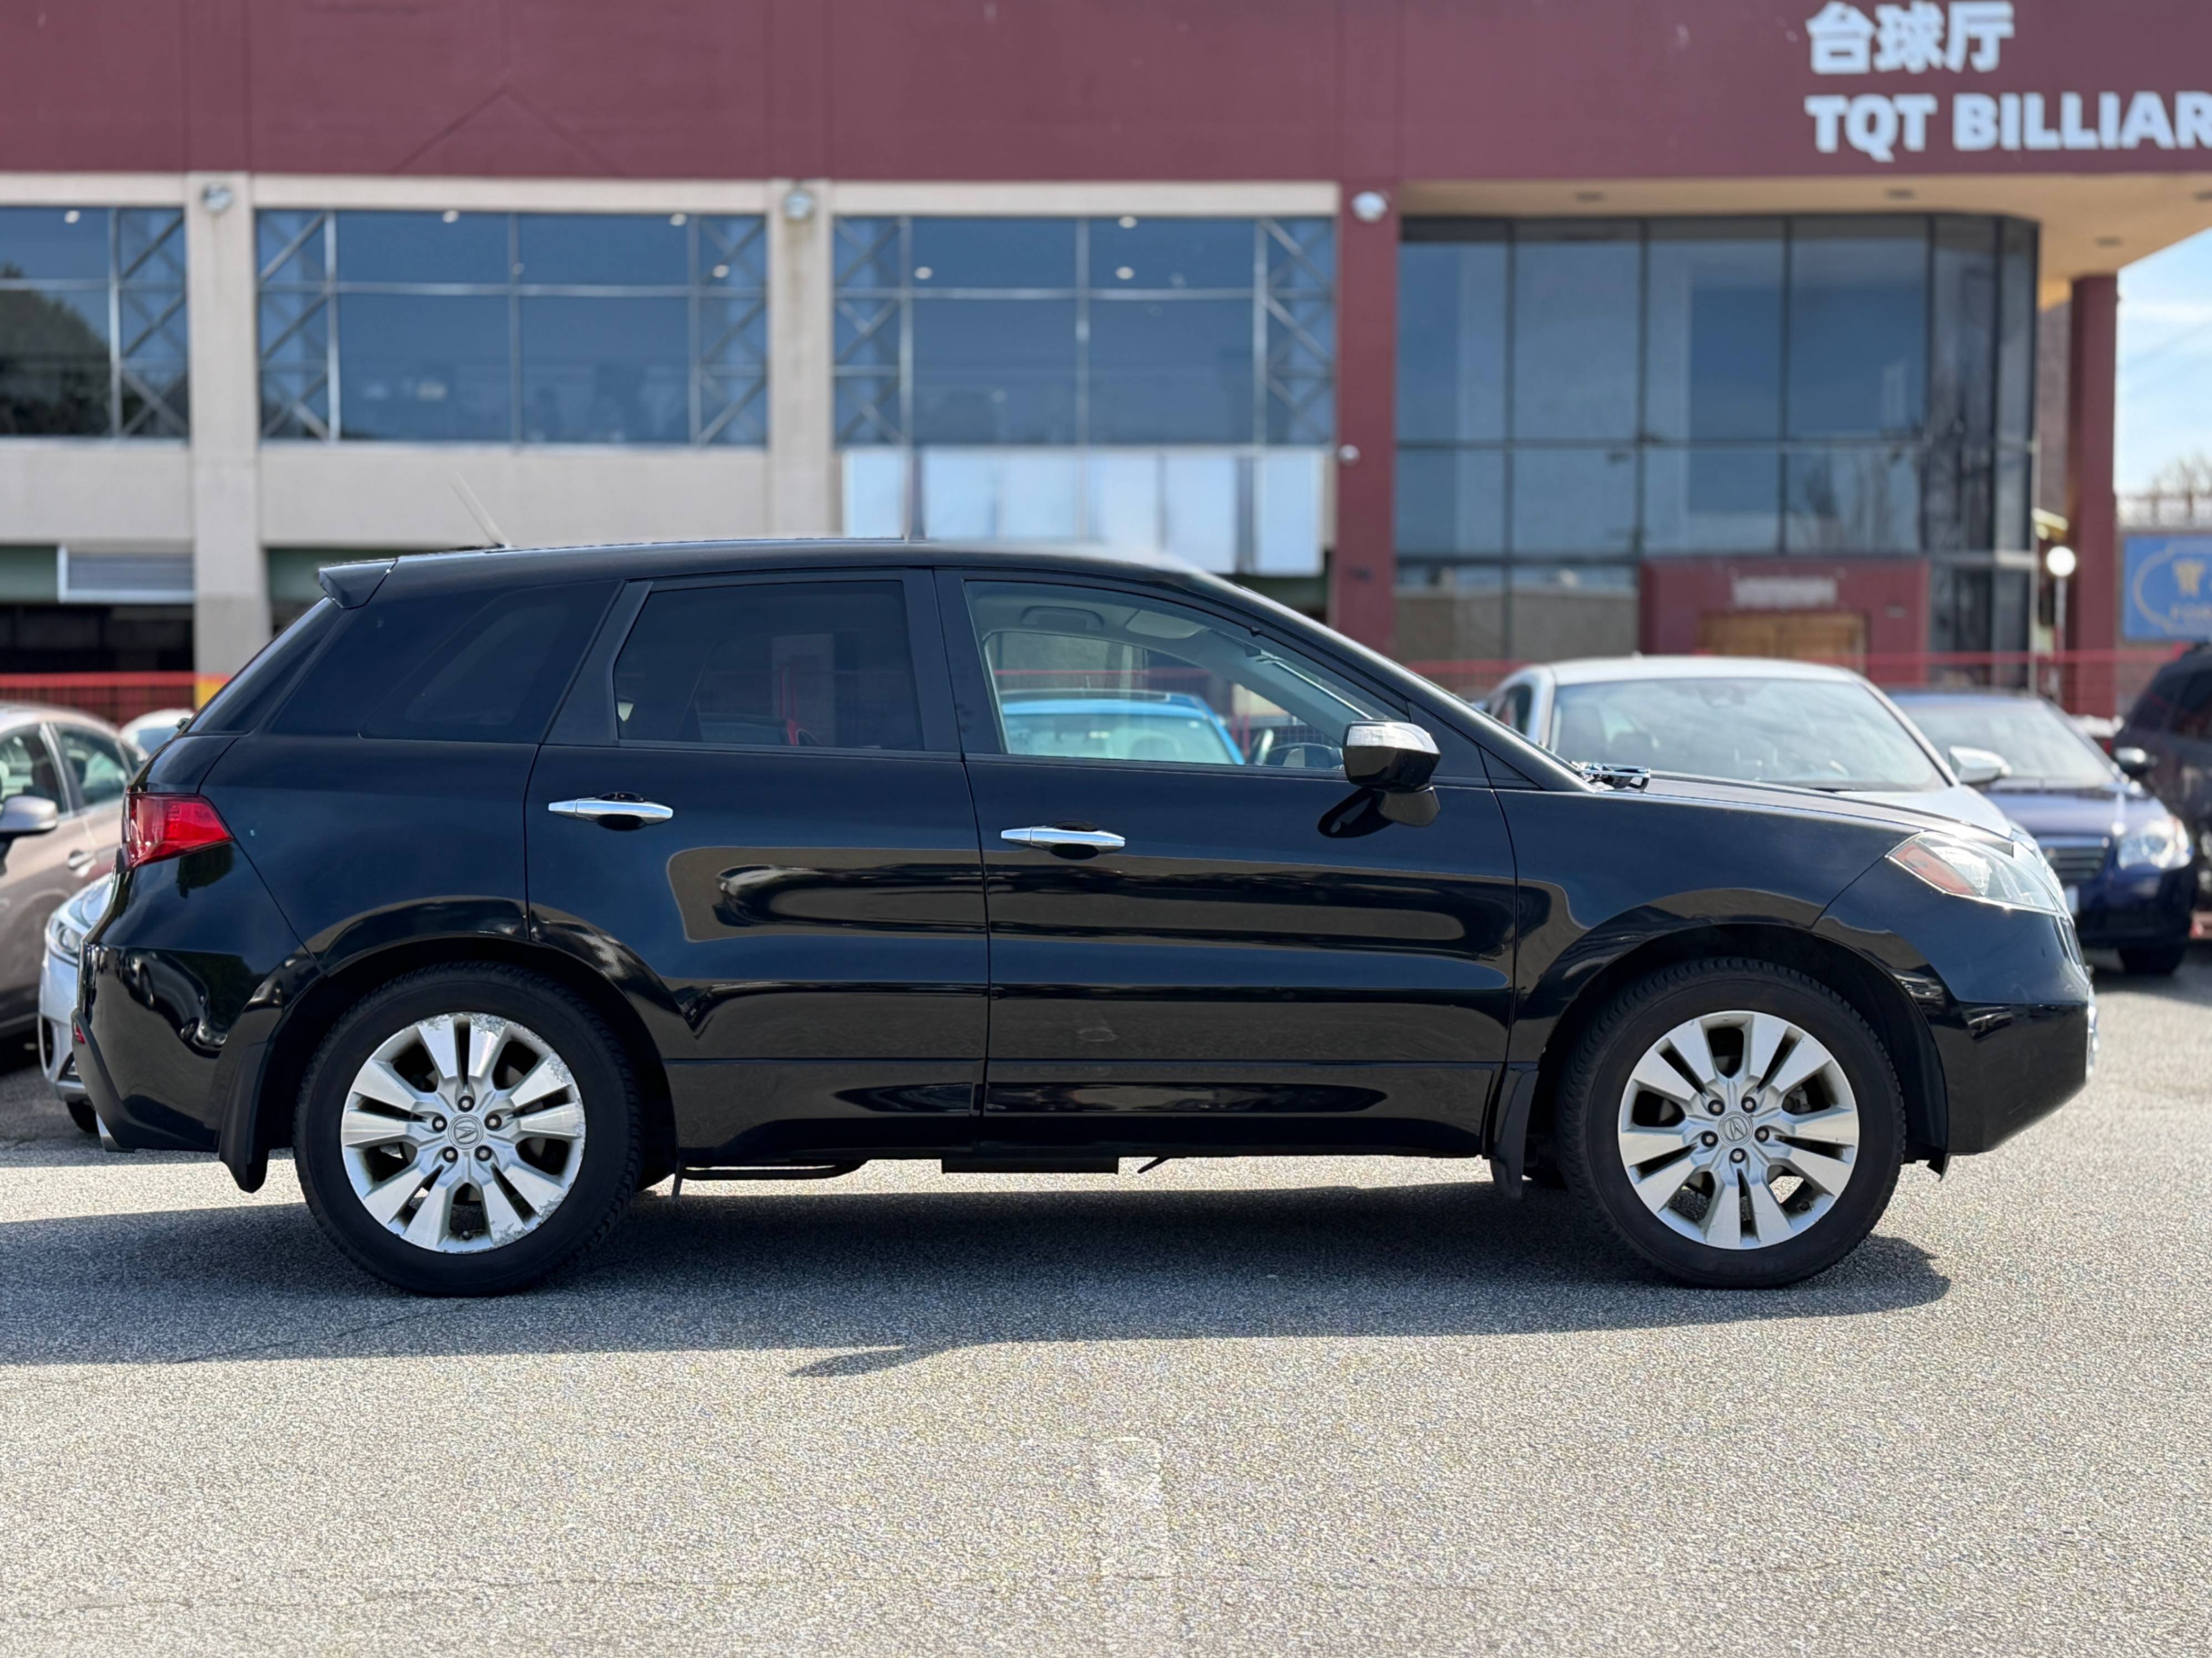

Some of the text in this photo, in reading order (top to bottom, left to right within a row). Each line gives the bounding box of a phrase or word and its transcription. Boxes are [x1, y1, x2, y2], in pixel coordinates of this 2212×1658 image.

[1806, 1, 2014, 74] 台球厅
[1804, 91, 2212, 161] TQT BILLIAR
